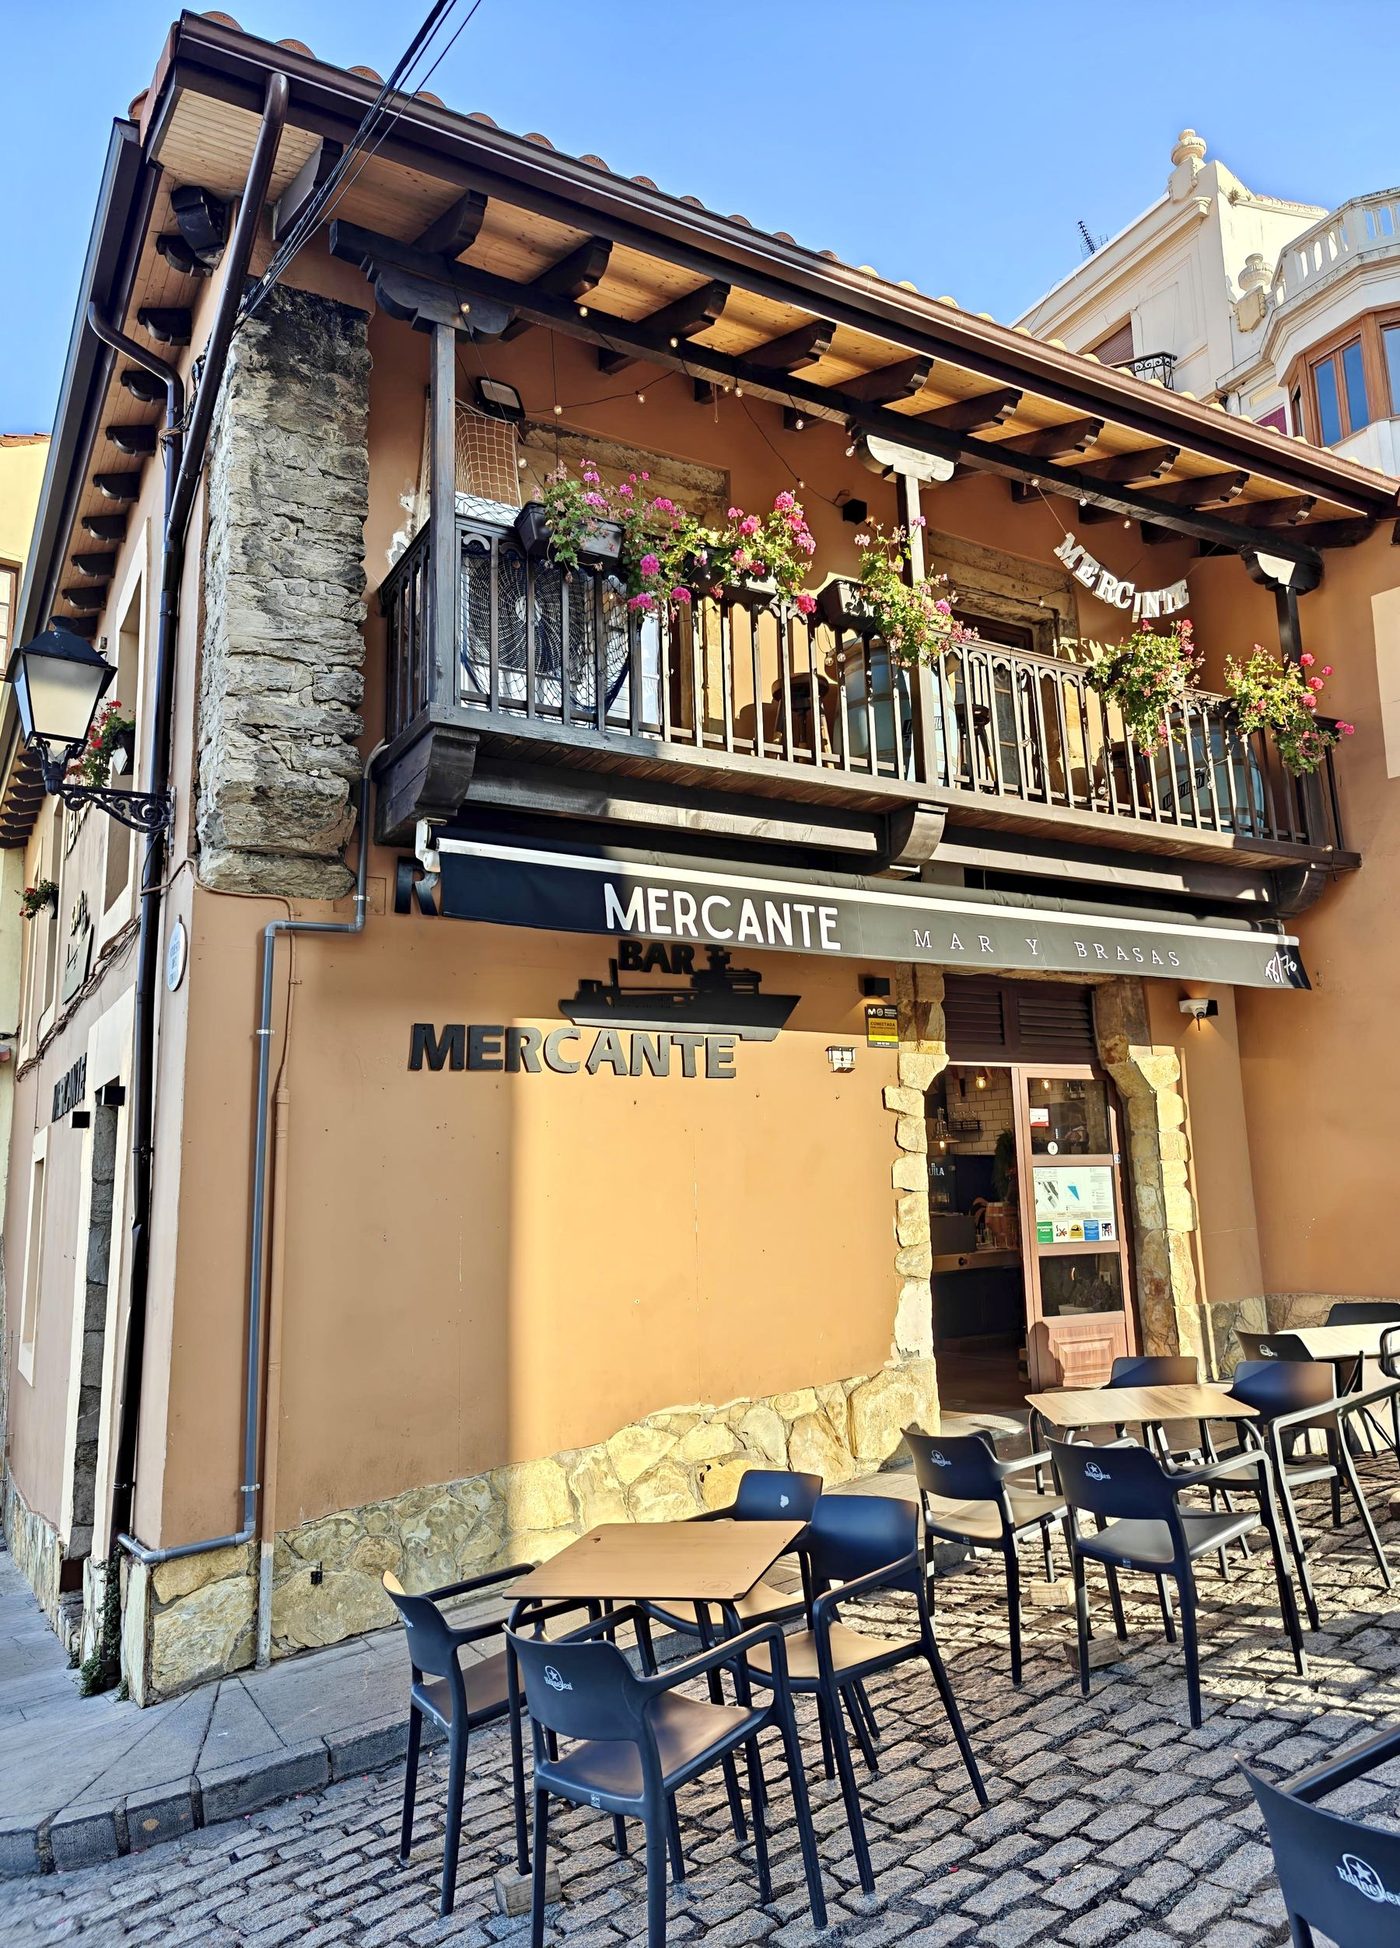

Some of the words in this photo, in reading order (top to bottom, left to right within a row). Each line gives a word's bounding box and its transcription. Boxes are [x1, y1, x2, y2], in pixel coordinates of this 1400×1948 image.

[603, 883, 842, 950] MERCANTE
[618, 940, 695, 975] BAR
[913, 929, 994, 953] MAR
[1025, 938, 1040, 955] Y
[1073, 941, 1181, 967] BRASAS
[408, 1023, 736, 1078] MERCANTE
